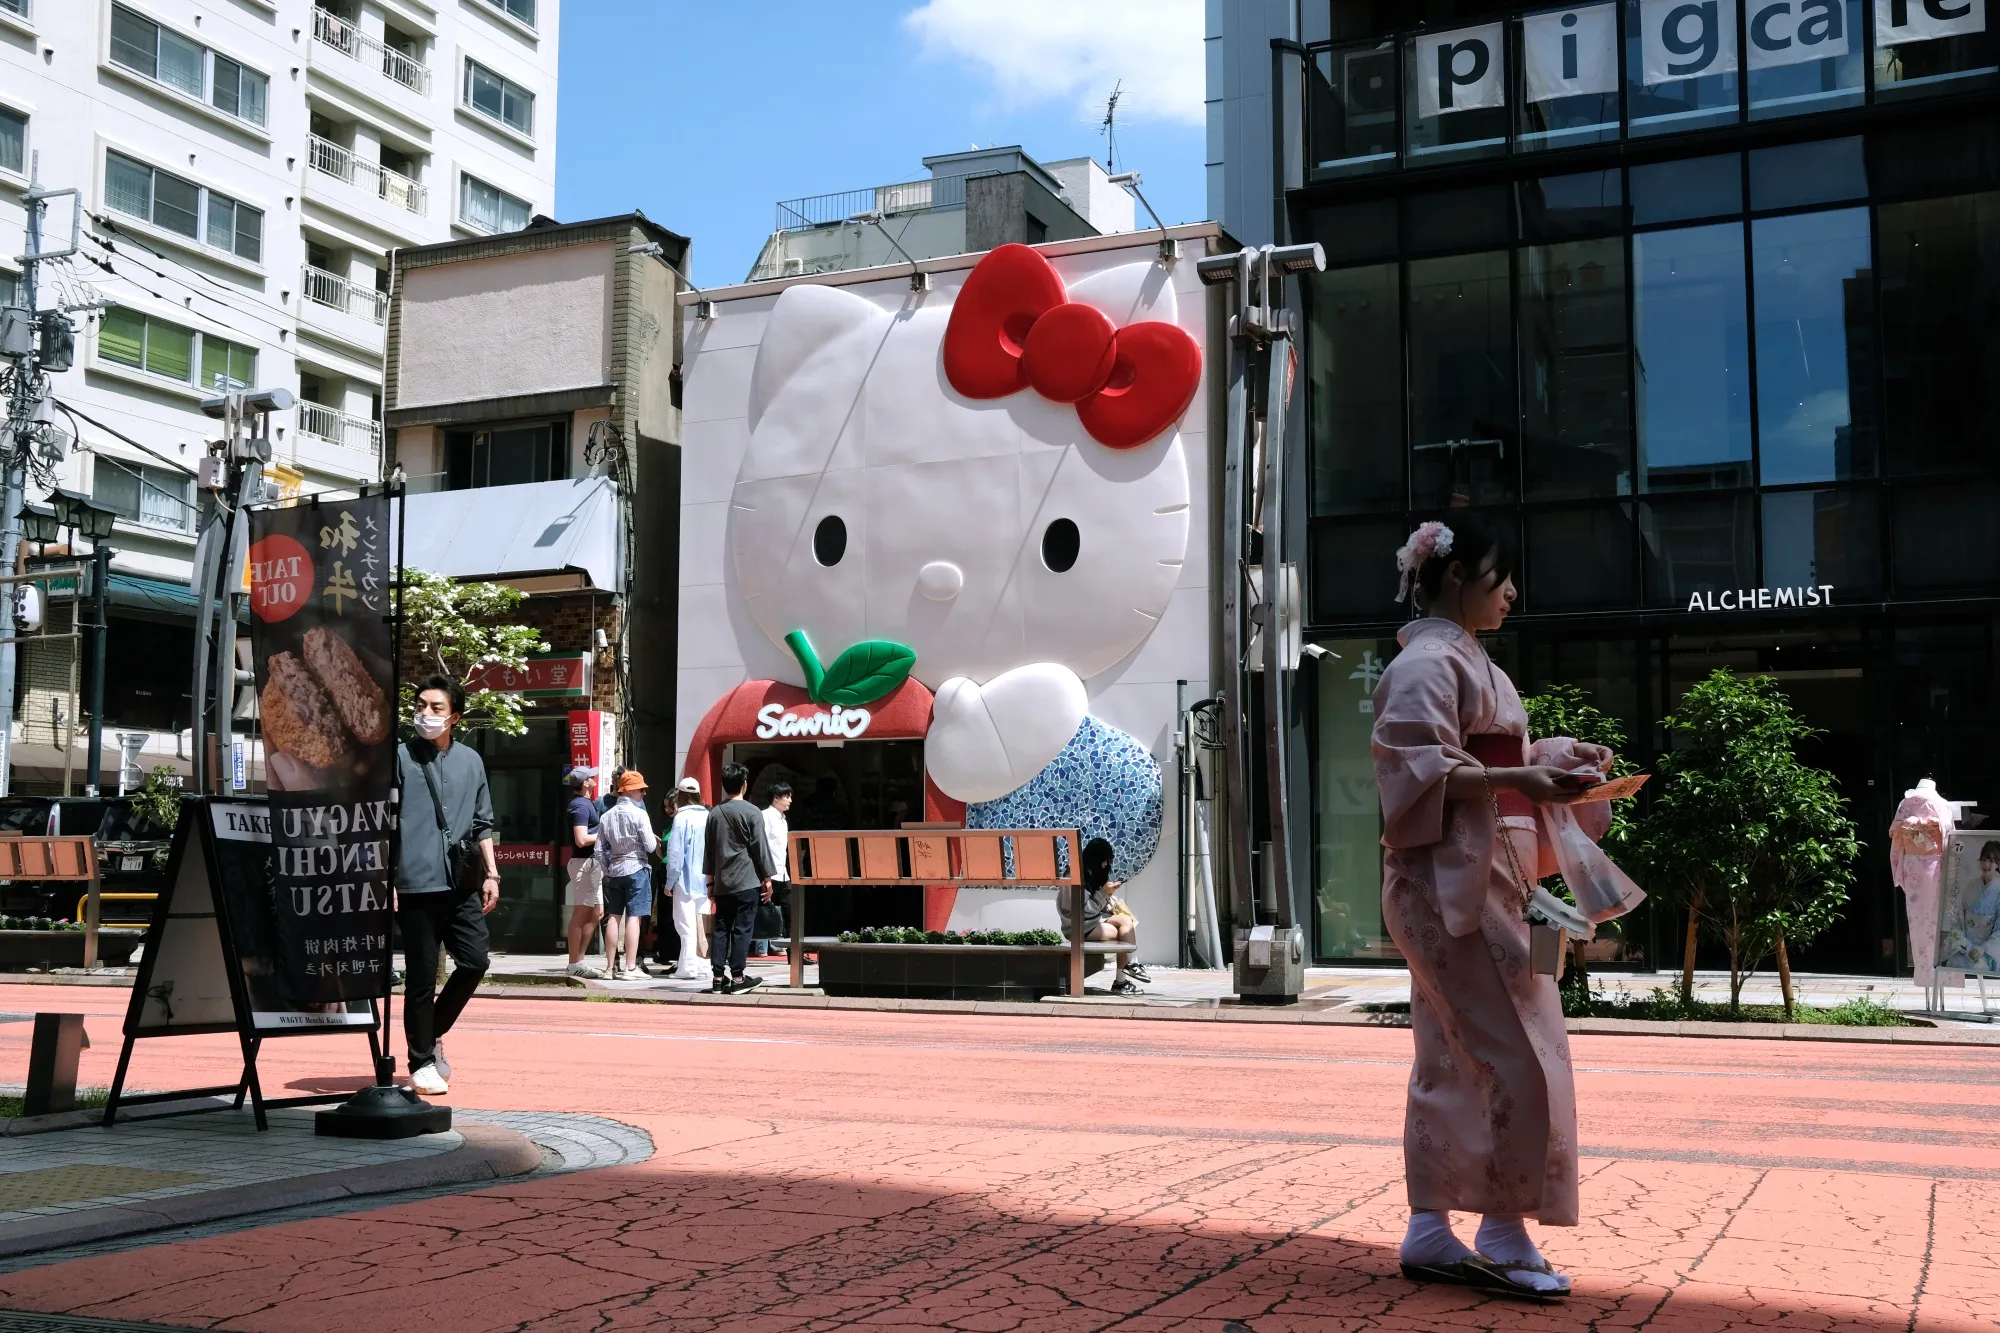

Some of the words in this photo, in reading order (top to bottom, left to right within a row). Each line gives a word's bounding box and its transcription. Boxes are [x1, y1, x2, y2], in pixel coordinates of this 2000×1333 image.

[1688, 585, 1835, 612] ALCHEMIST
[756, 703, 871, 739] Sanrio
[226, 812, 272, 834] TAKE
[279, 1016, 303, 1024] WAGYU
[305, 1016, 325, 1024] Menchi
